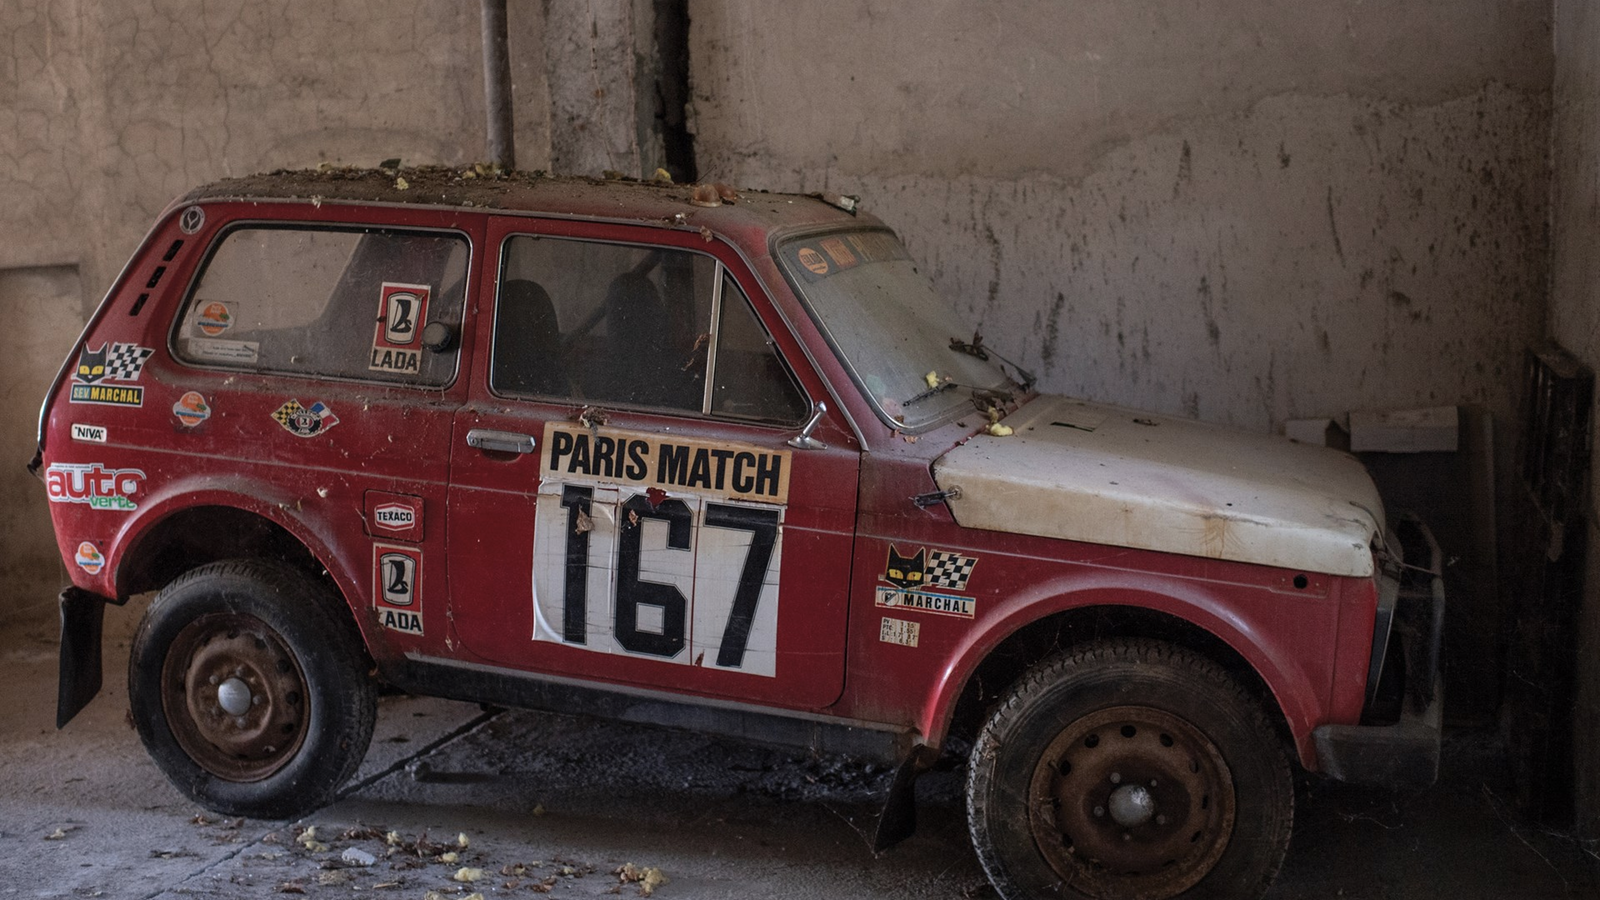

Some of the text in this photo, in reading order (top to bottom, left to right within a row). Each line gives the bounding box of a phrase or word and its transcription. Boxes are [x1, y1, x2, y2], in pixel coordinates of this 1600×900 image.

[371, 350, 418, 371] LADA
[91, 388, 140, 404] MARCHAL
[550, 431, 782, 497] PARIS MATCH
[48, 467, 141, 498] auto
[377, 511, 413, 522] TEXACO
[560, 482, 782, 668] 167
[903, 594, 969, 613] MARCHAL
[384, 611, 422, 632] ADA
